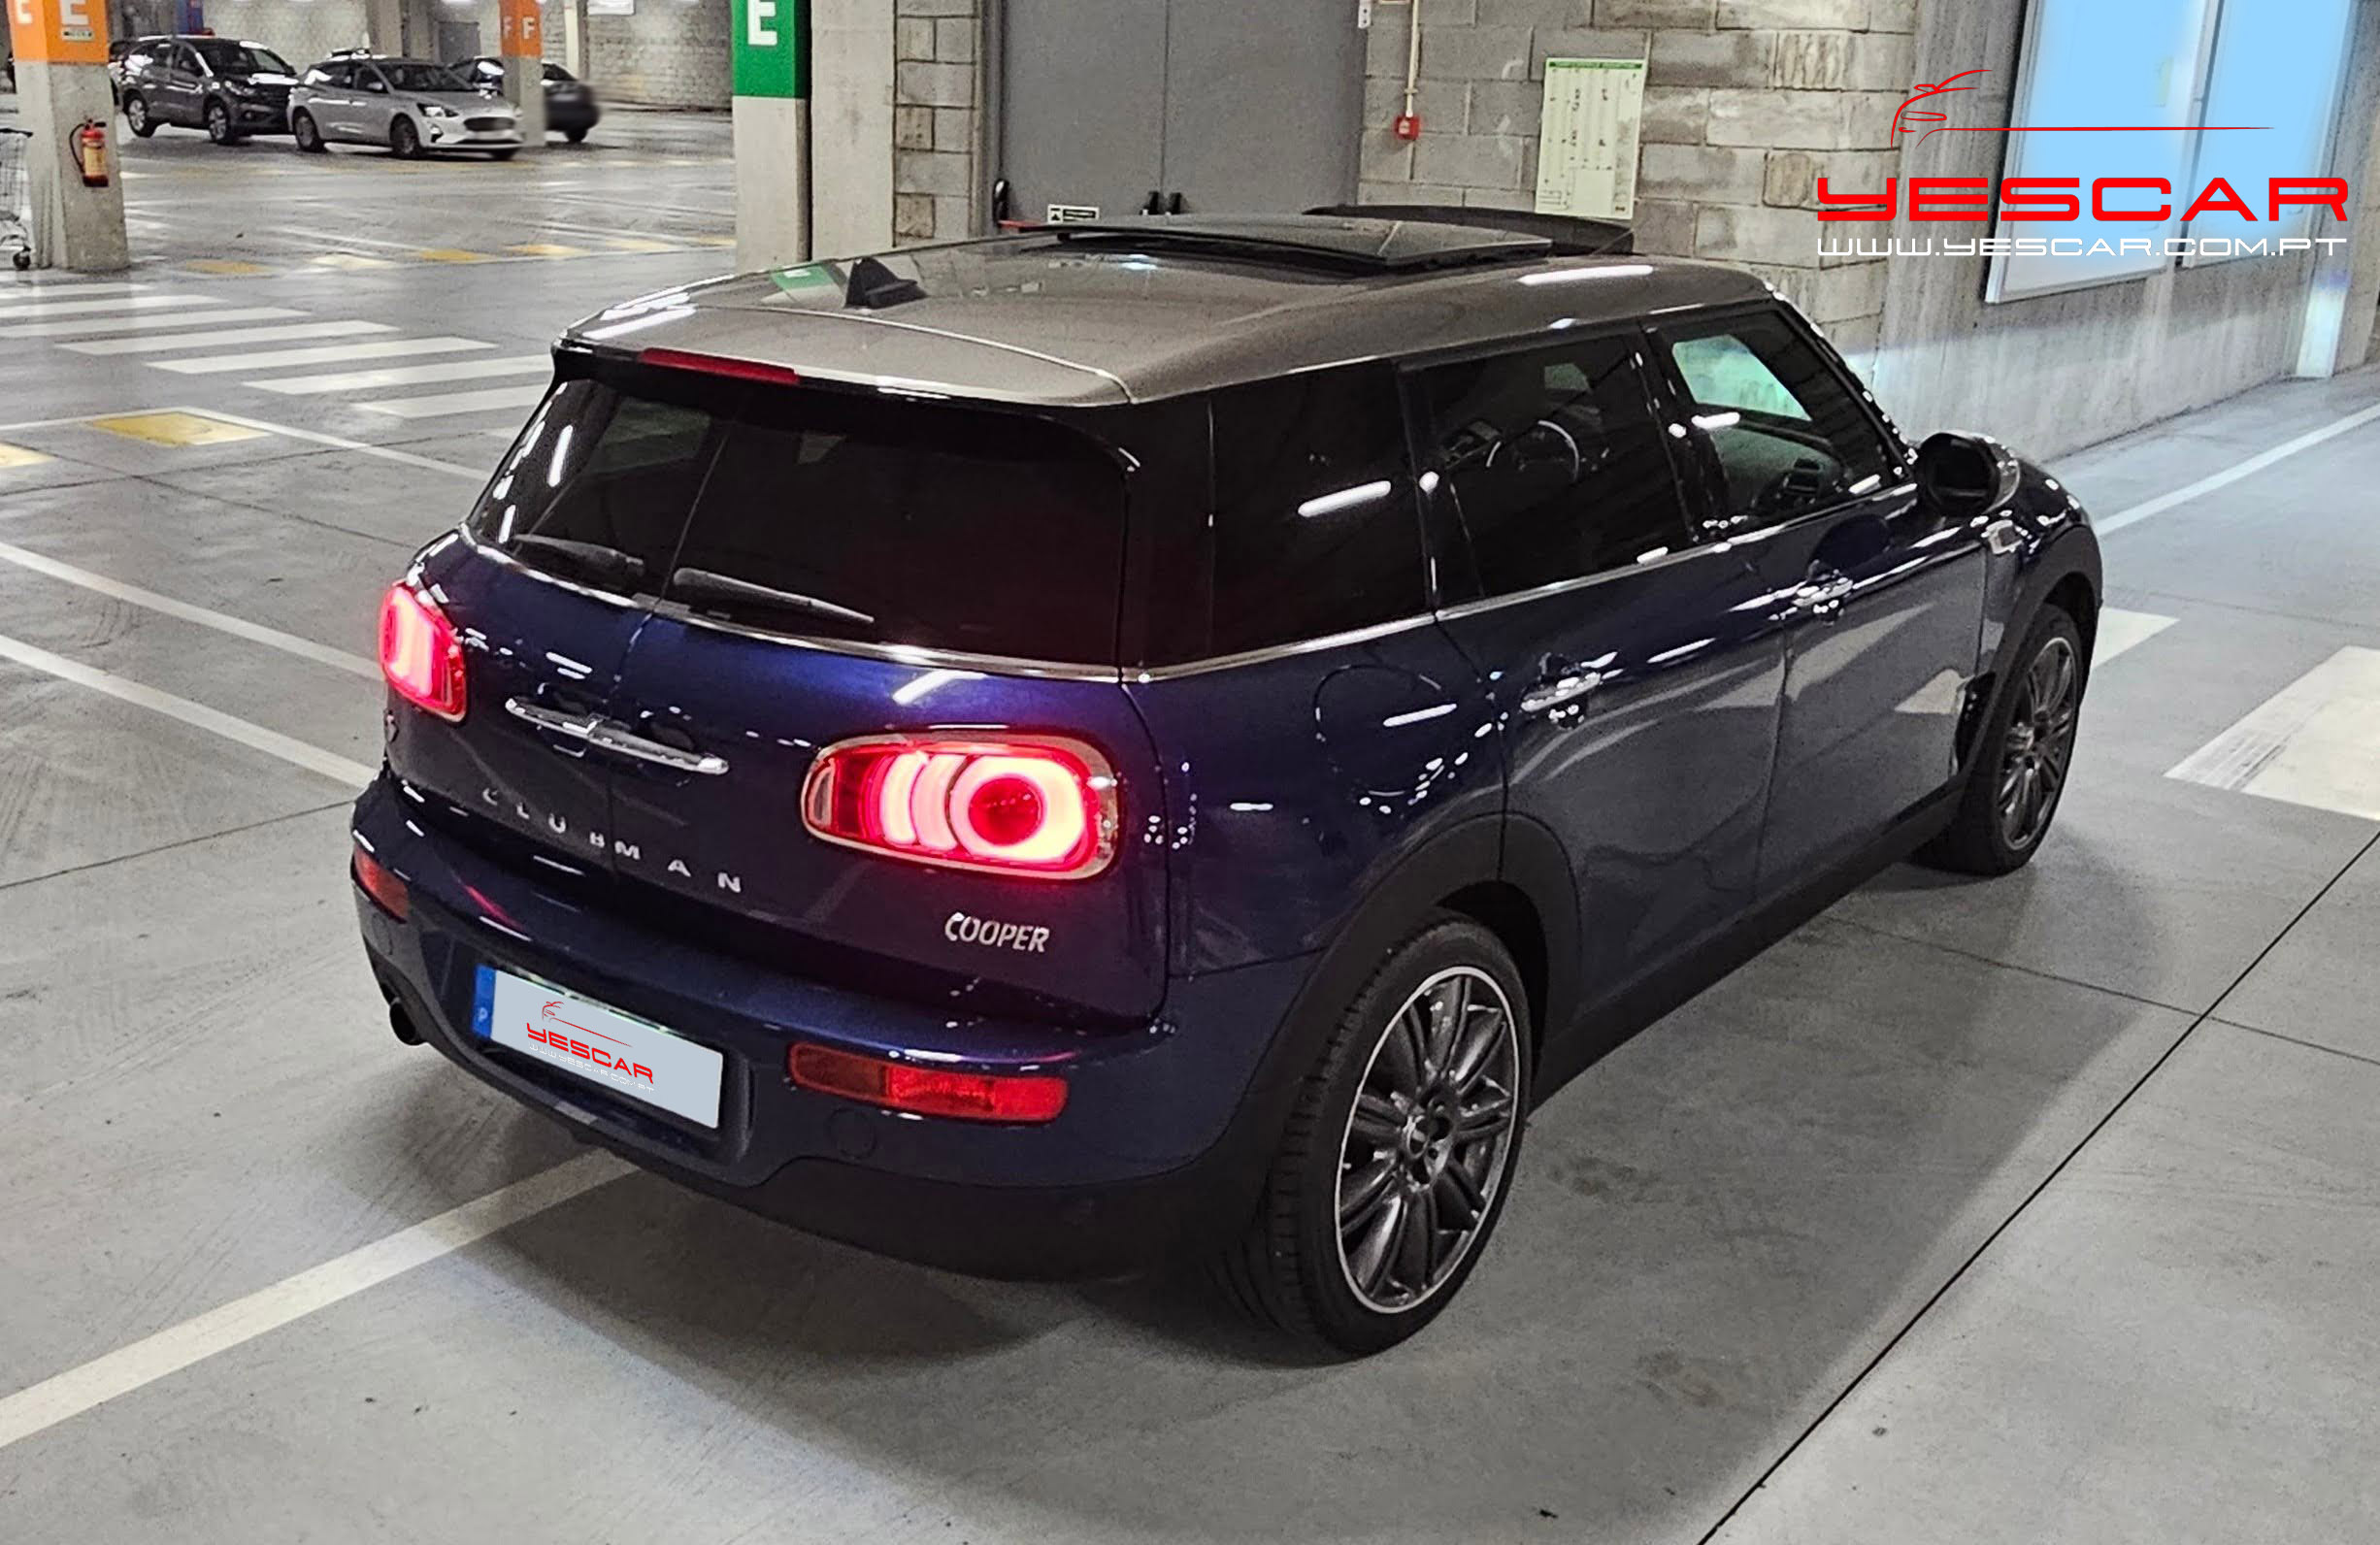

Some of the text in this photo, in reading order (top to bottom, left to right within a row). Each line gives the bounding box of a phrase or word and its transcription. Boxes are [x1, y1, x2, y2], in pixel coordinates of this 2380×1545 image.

[522, 16, 535, 40] F
[746, 0, 777, 46] E
[482, 787, 742, 894] CLUBMAN
[944, 911, 1050, 952] COOPER
